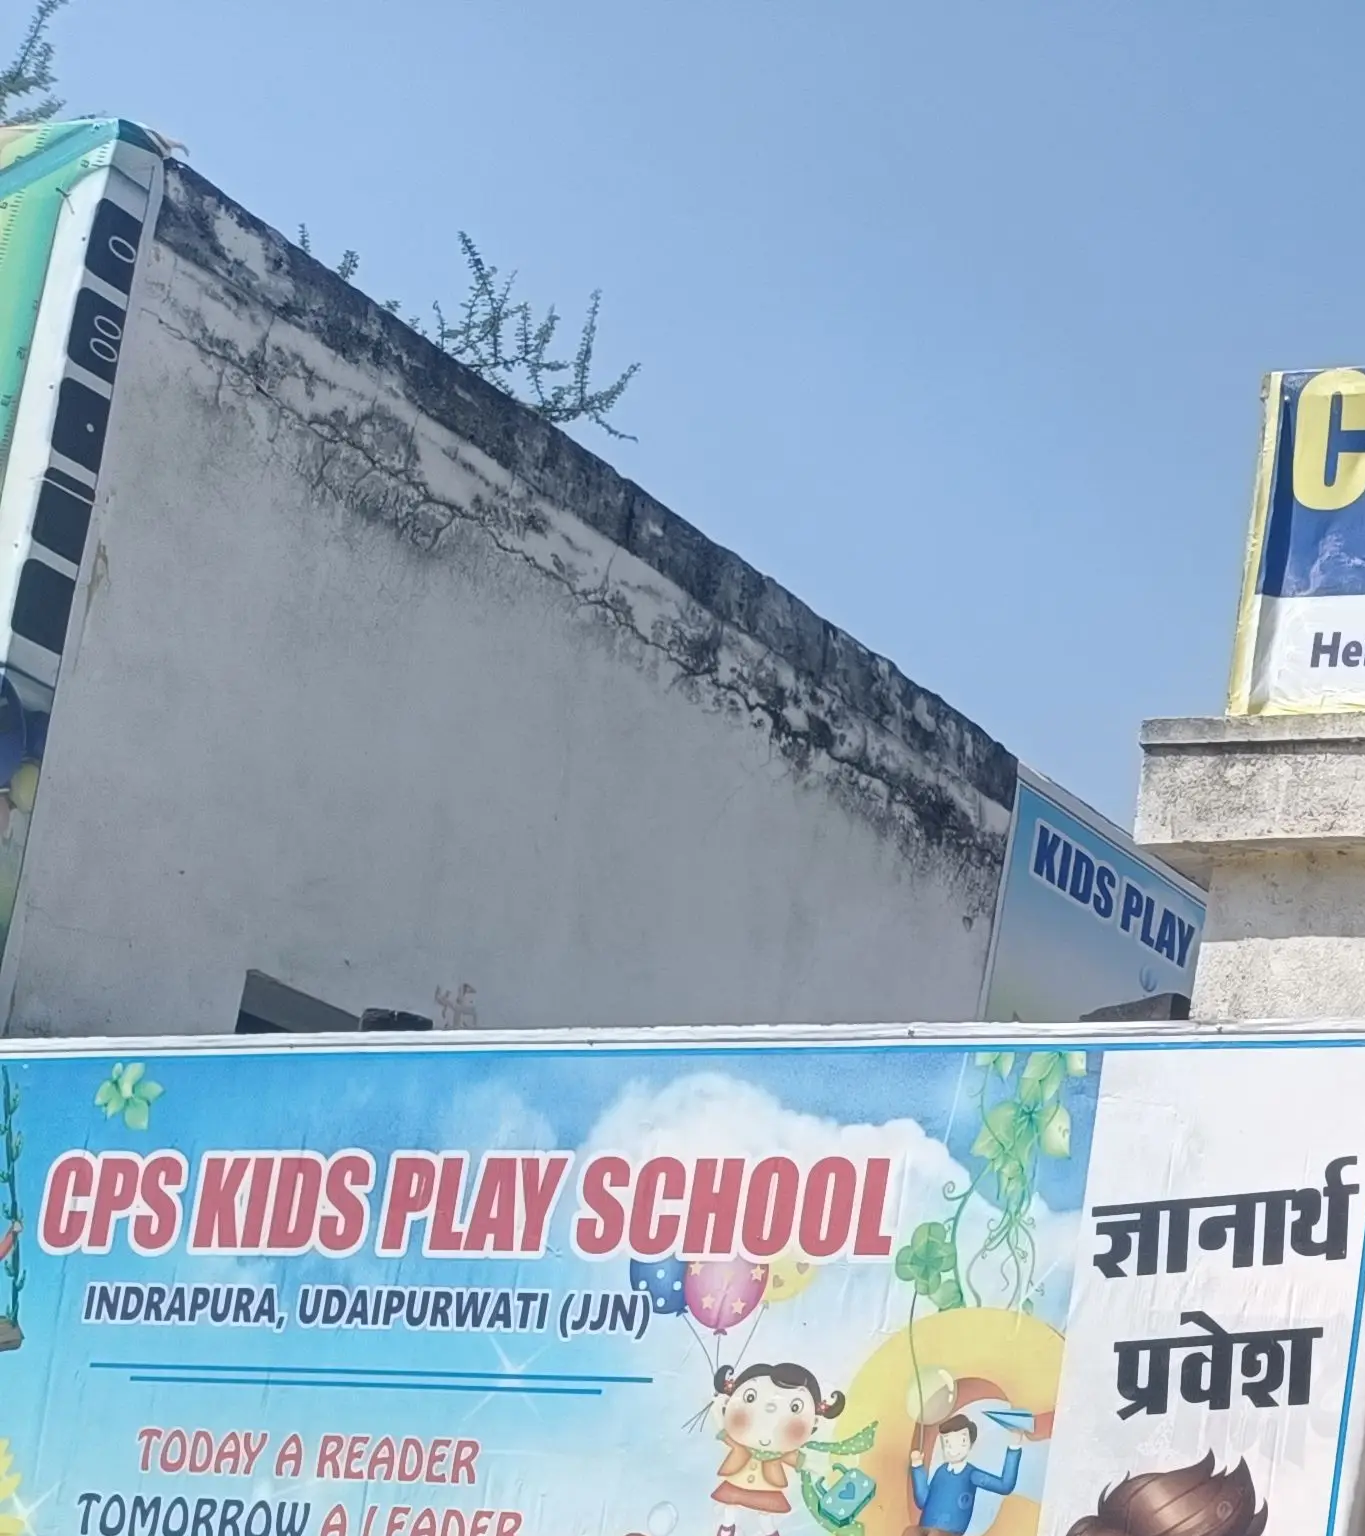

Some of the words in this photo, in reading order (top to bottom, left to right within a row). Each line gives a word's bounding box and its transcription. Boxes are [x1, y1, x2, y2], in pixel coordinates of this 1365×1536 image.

[1033, 824, 1116, 919] KIDS
[1120, 882, 1196, 968] PLAY
[43, 1156, 184, 1251] CPS
[192, 1156, 373, 1251] KIDS
[380, 1157, 569, 1252] PLAY
[578, 1156, 893, 1256] SCHOOL
[1091, 1156, 1360, 1279] ज्ञानार्थ
[83, 1285, 288, 1329] INDRAPURA,
[299, 1287, 546, 1330] UDAIPURWATI
[558, 1290, 652, 1339] (JJN)
[1114, 1311, 1323, 1420] प्रवेश
[137, 1429, 269, 1476] TODAY
[277, 1434, 303, 1477] A
[316, 1433, 480, 1485] READER
